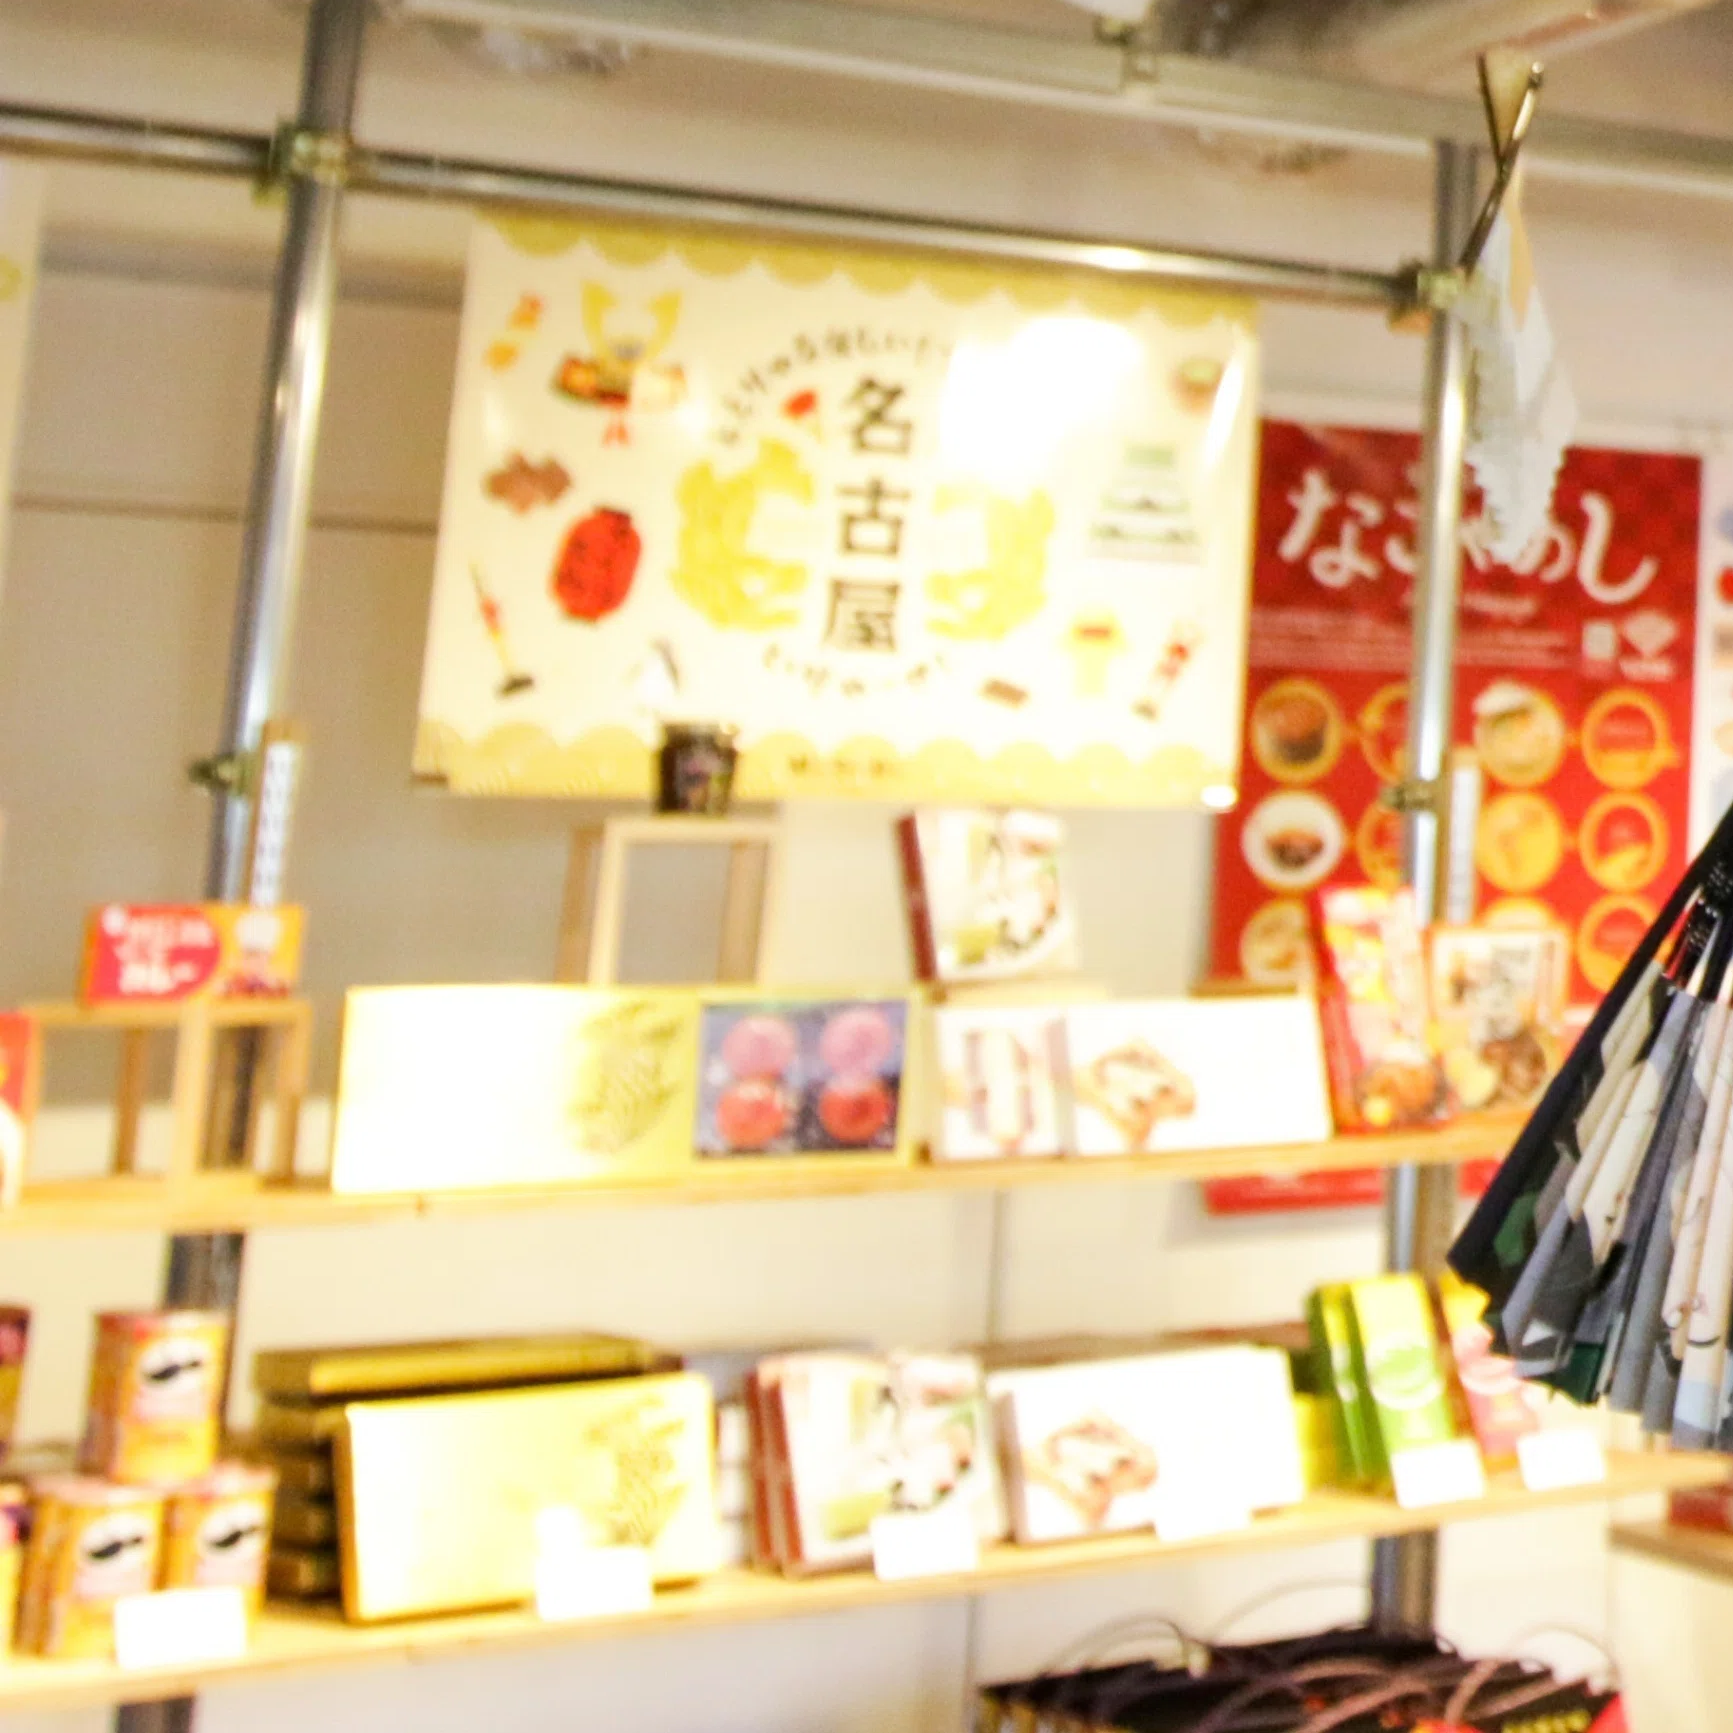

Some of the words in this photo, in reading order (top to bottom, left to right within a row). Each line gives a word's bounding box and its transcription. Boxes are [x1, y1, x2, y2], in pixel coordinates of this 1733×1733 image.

[822, 375, 913, 652] 名古屋
[1277, 463, 1660, 606] なめし
